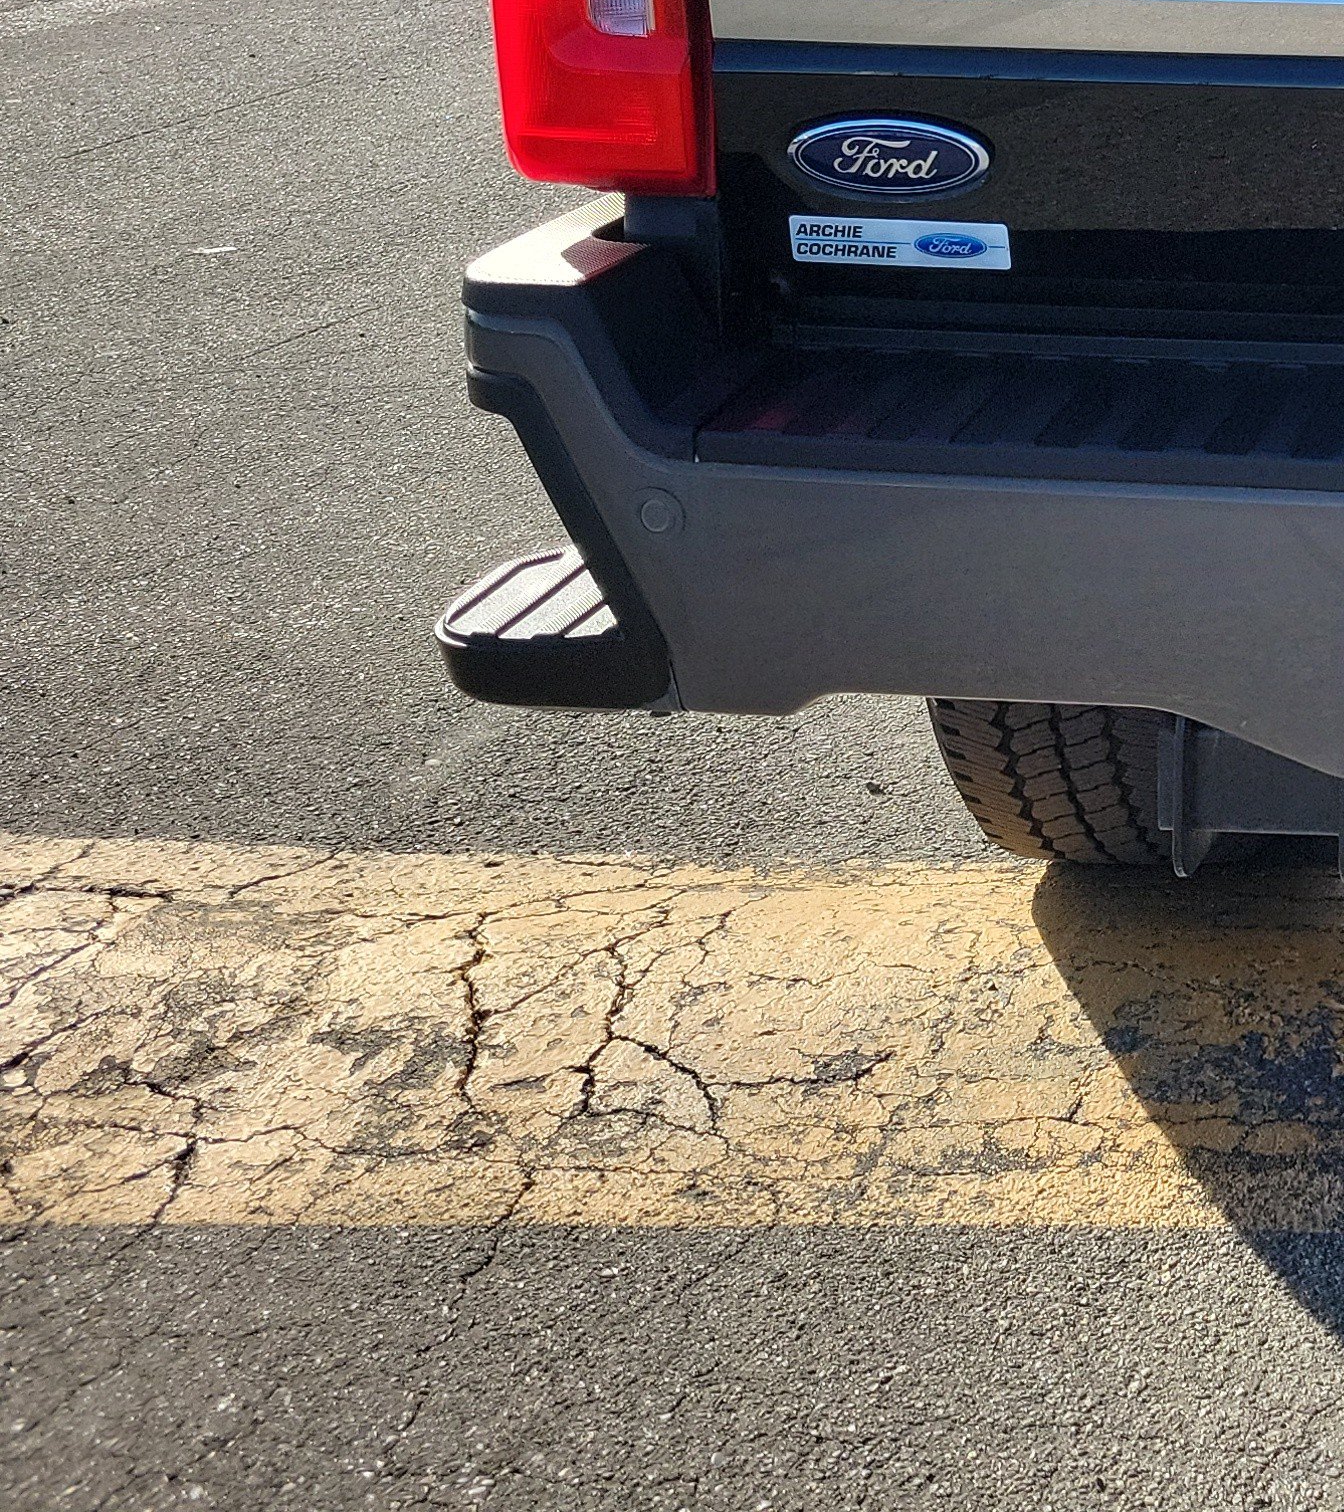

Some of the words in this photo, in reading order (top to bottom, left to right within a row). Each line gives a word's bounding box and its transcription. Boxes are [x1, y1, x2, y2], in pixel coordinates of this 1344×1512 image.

[833, 136, 938, 179] Ford
[795, 223, 863, 239] ARCHIE
[796, 242, 897, 258] COCHRANE
[928, 238, 973, 255] Ford
